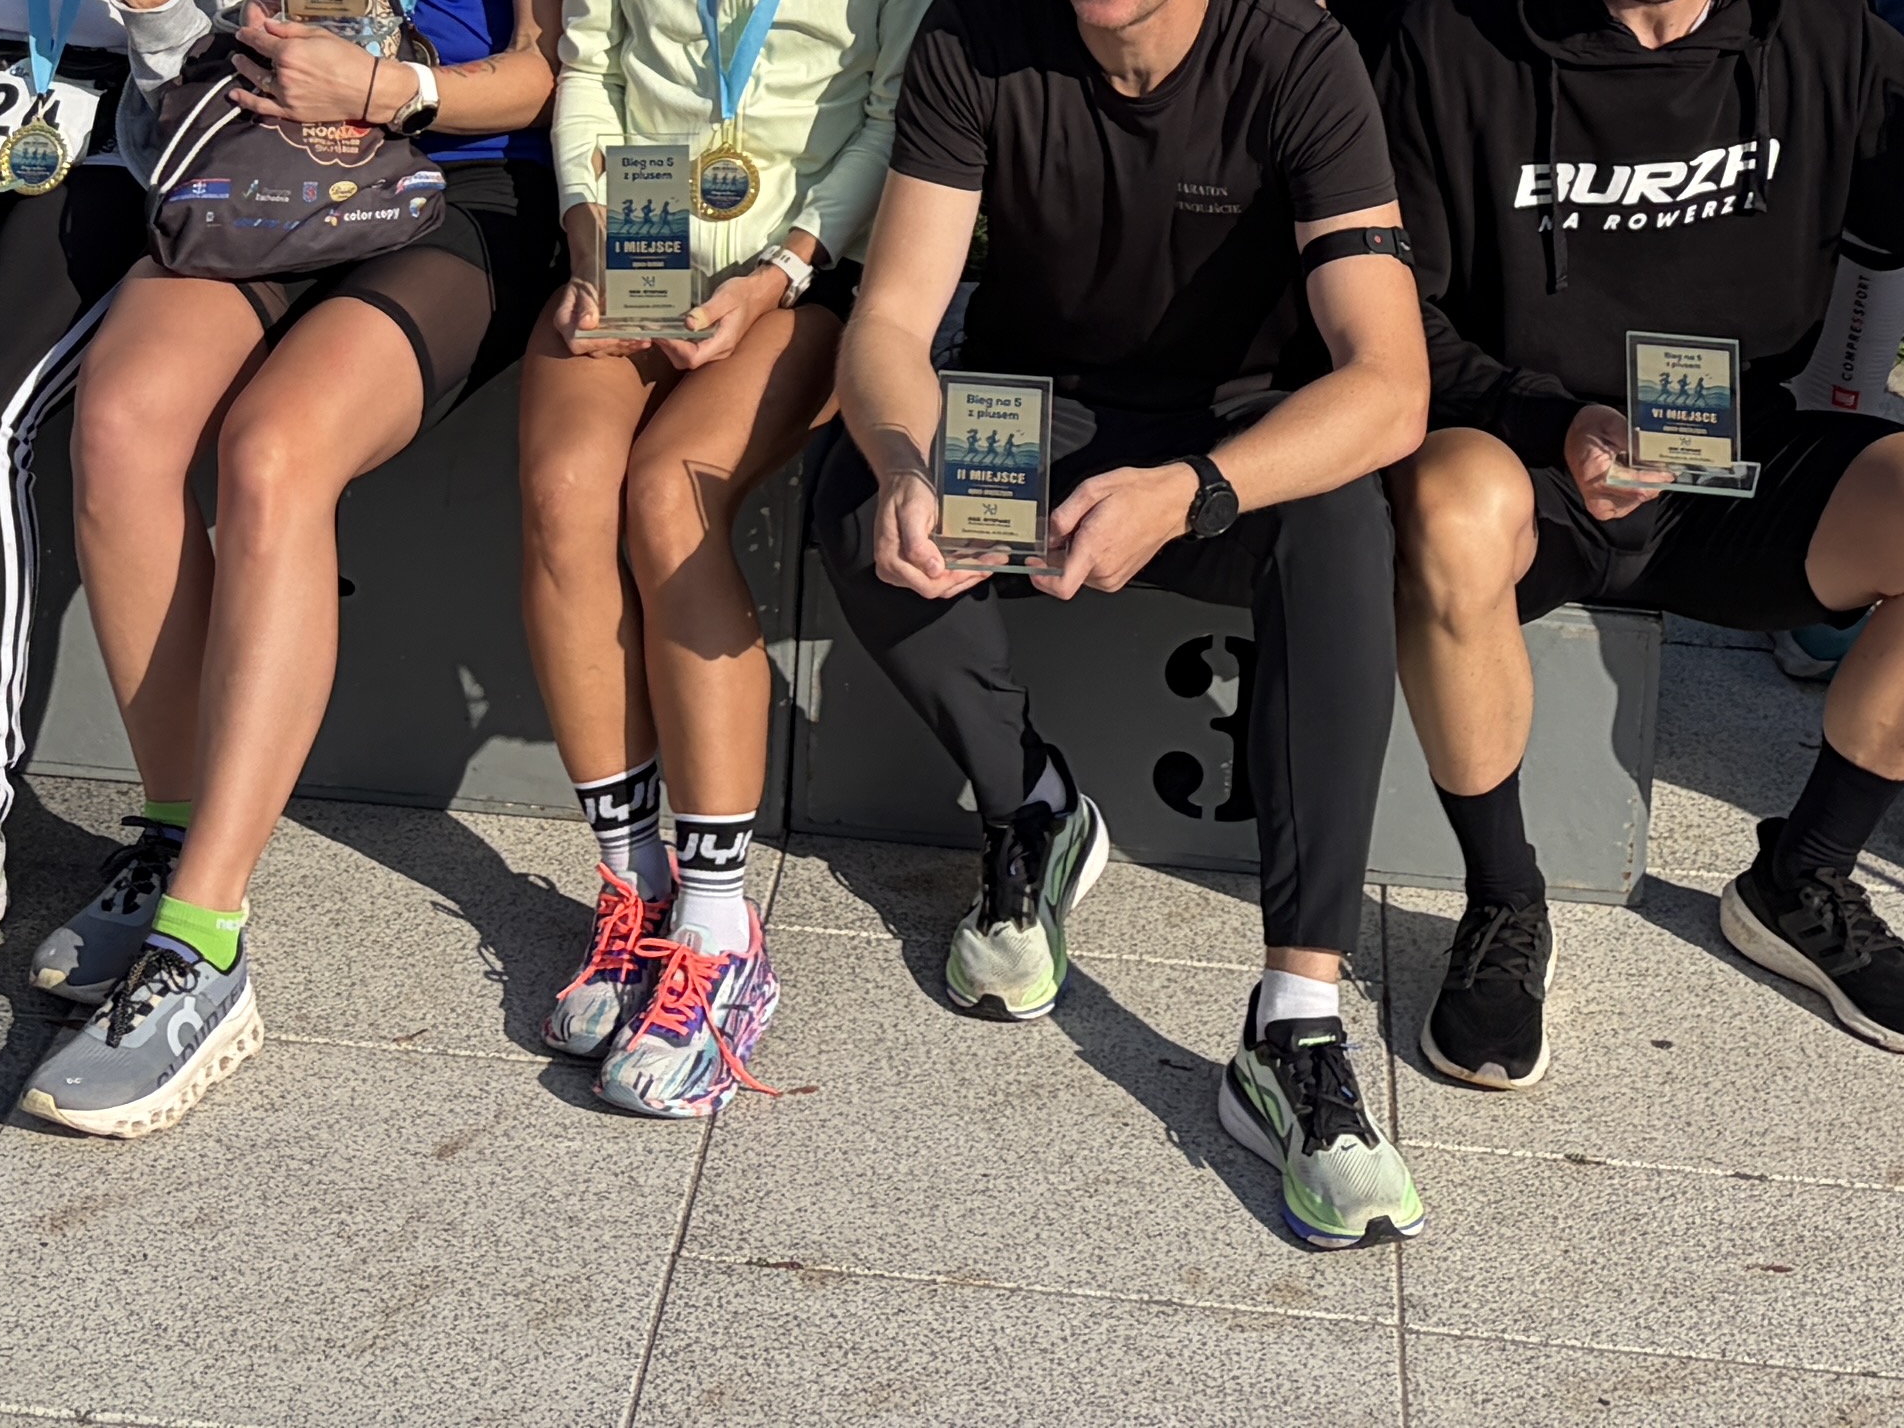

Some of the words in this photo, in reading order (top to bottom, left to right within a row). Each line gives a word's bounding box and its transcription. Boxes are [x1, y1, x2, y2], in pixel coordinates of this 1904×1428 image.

[621, 157, 647, 170] Bieg
[648, 158, 663, 167] na
[632, 170, 672, 182] plusem
[343, 209, 373, 222] color
[375, 207, 400, 225] copy
[615, 241, 620, 253] I
[623, 240, 681, 254] MIEJSCE
[1840, 273, 1872, 383] COMPRESSPORT
[966, 393, 992, 408] Bieg
[994, 398, 1011, 407] na
[1014, 397, 1022, 407] 5
[967, 409, 974, 418] z
[977, 408, 1020, 422] plusem
[1666, 408, 1718, 424] MIEJSCE
[956, 467, 967, 480] II
[969, 468, 1026, 485] MIEJSCE
